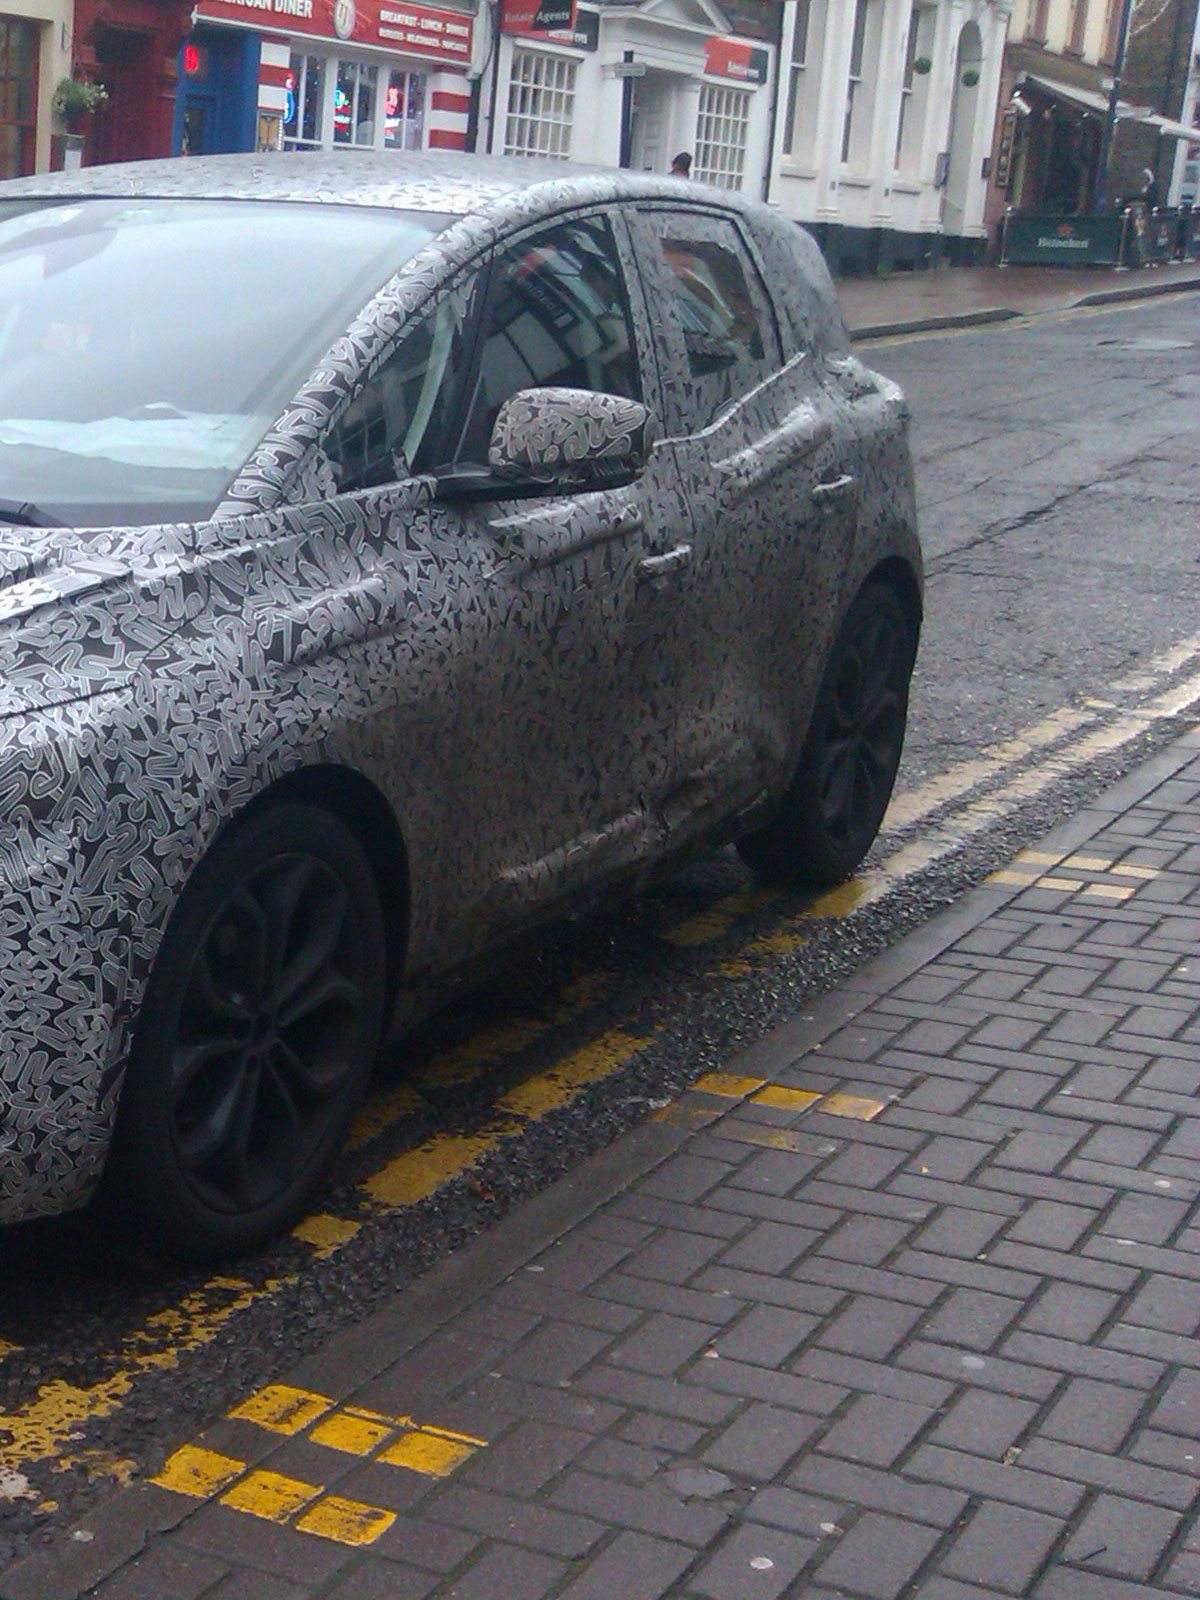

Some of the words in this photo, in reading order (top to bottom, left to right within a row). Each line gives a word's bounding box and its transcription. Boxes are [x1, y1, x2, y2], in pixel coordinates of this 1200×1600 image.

[275, 0, 312, 18] DINER
[536, 11, 569, 23] Agents
[1037, 237, 1089, 248] Heineken
